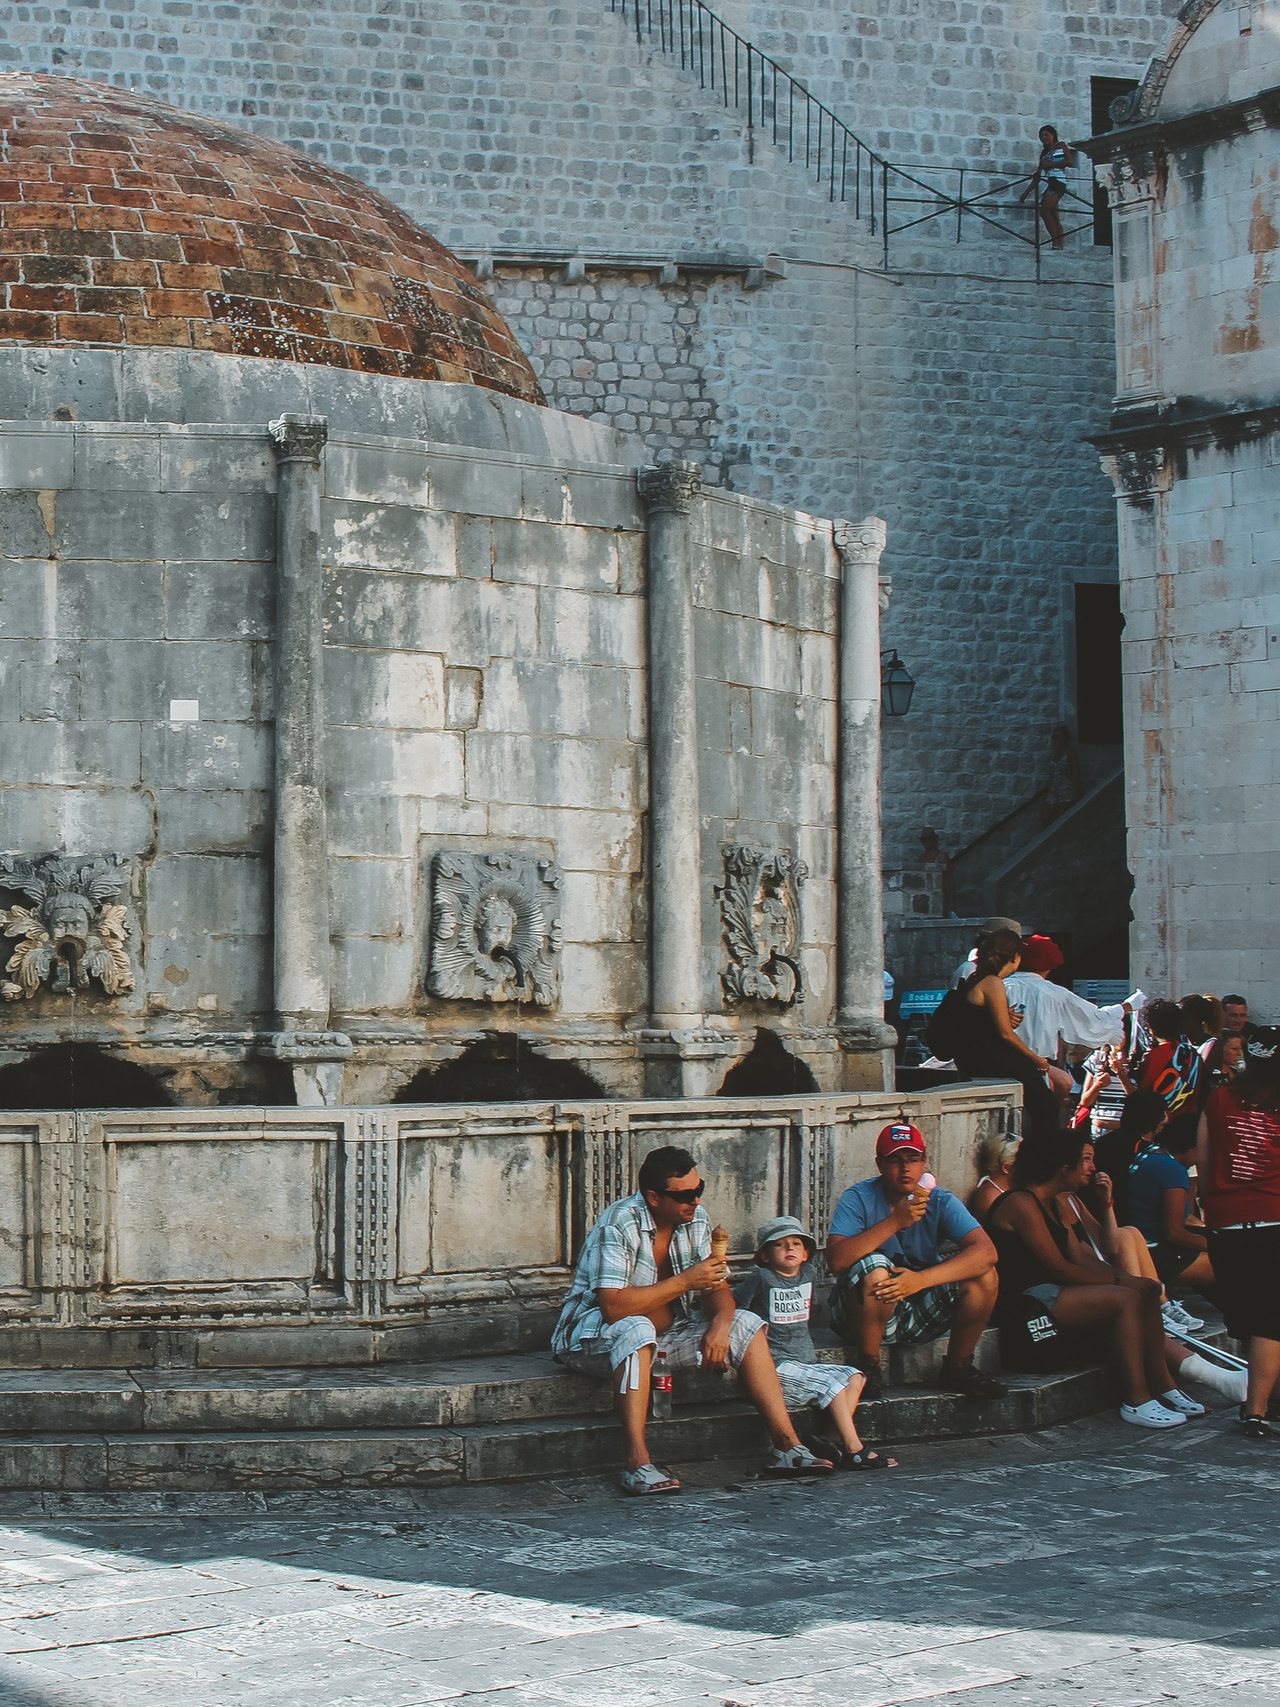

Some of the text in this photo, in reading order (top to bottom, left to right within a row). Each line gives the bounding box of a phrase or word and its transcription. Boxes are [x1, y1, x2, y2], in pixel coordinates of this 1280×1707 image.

[908, 993, 934, 1001] Books
[774, 1290, 803, 1301] LONDON
[774, 1301, 800, 1312] ROCKS
